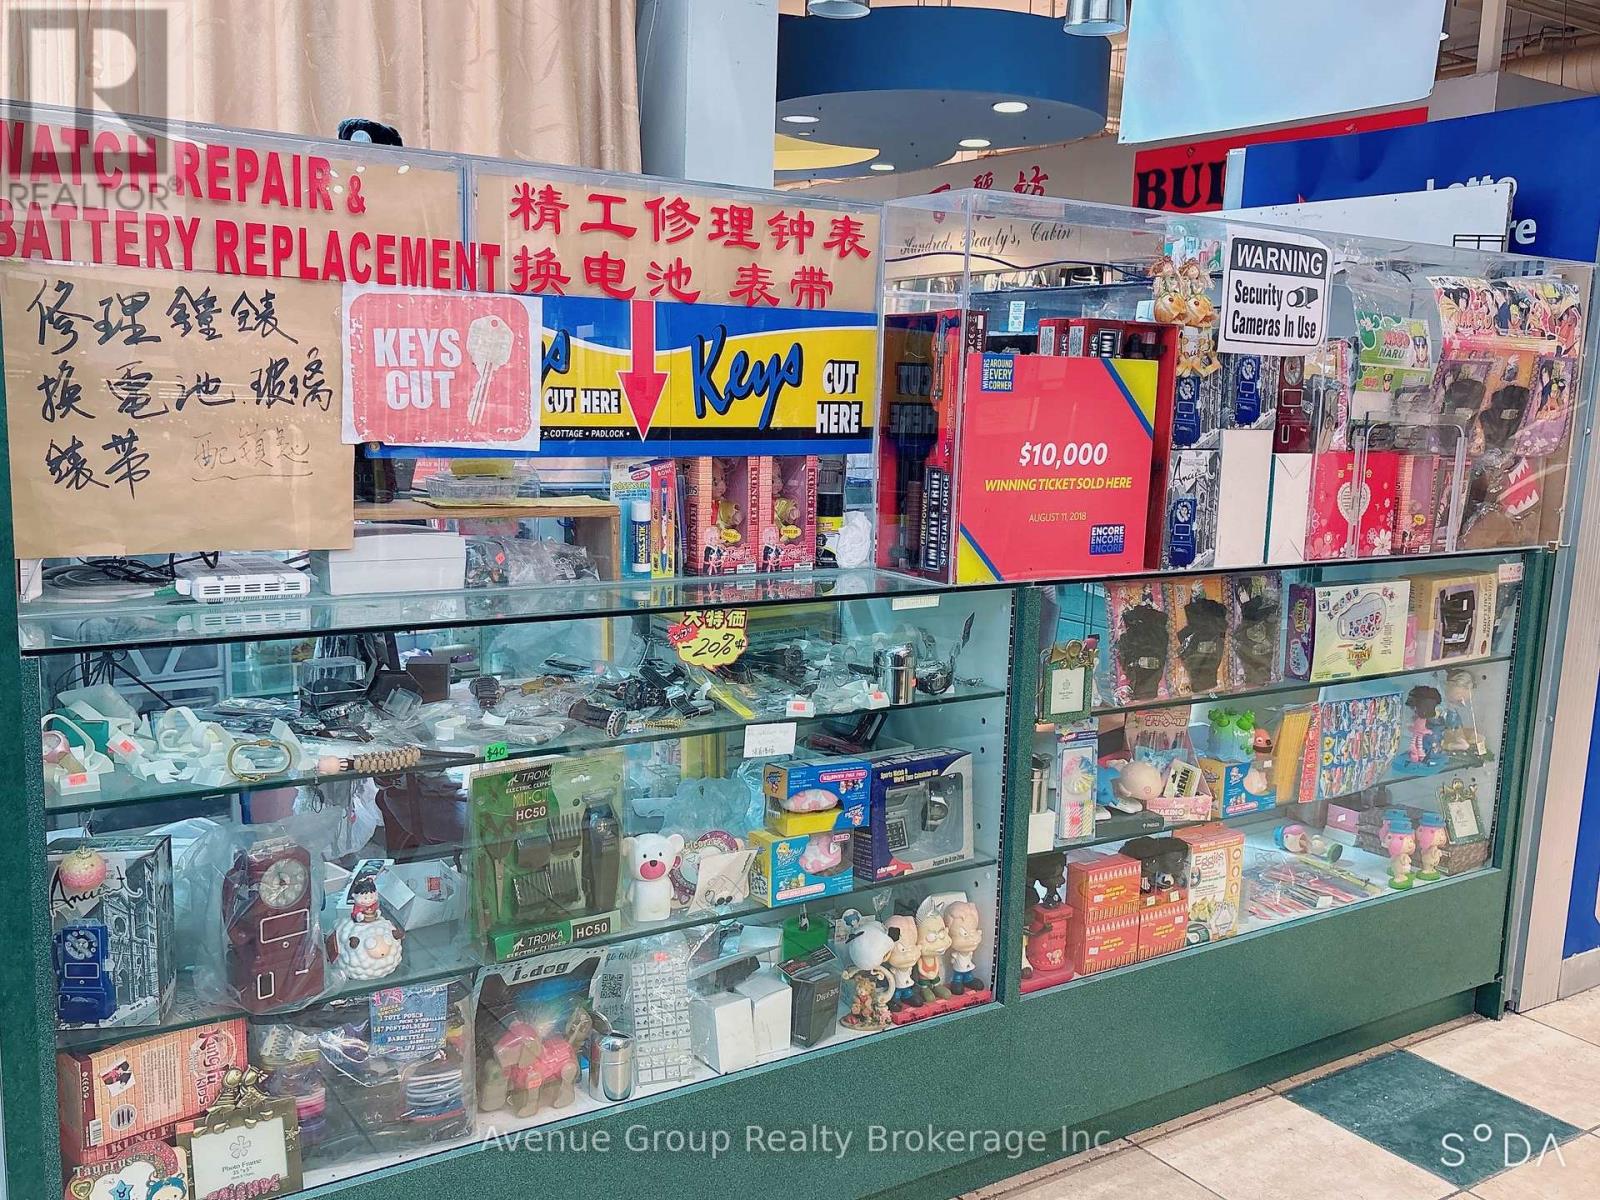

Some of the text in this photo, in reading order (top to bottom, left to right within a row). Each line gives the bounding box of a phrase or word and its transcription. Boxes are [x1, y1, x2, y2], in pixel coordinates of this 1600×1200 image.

[173, 142, 334, 211] REPAIR
[347, 175, 367, 215] &
[509, 181, 872, 260] 精工修理钟表
[0, 197, 501, 293] BATTERY REPLACEMENT
[1237, 246, 1323, 277] WARNING
[509, 245, 833, 309] 换电池 表带
[1234, 279, 1283, 311] Security
[1231, 309, 1317, 340] Cameras In Use
[372, 327, 463, 368] KEYS
[690, 323, 803, 430] Keys
[989, 359, 1013, 368] AROUND
[990, 369, 1013, 380] EVERY
[385, 370, 455, 410] CUT
[823, 360, 858, 394] CUT
[989, 380, 1012, 390] CORNER
[544, 387, 621, 413] CUT HERE
[815, 401, 863, 434] HERE
[550, 429, 625, 438] COTTAGE PADLOCK
[1019, 442, 1108, 469] $10,000
[985, 476, 1133, 491] WINNING TICKET SOLD HERE
[1029, 512, 1060, 522] AUGUST
[1070, 512, 1087, 521] 2018
[940, 515, 948, 565] SPECIAL
[1091, 535, 1124, 544] ENCORE
[1092, 526, 1125, 535] ENCORE
[1091, 544, 1123, 553] ENCORE
[683, 610, 747, 628] 大特価
[487, 747, 505, 760] $40
[516, 806, 546, 820] HC50
[528, 922, 608, 946] TROIKA HC50
